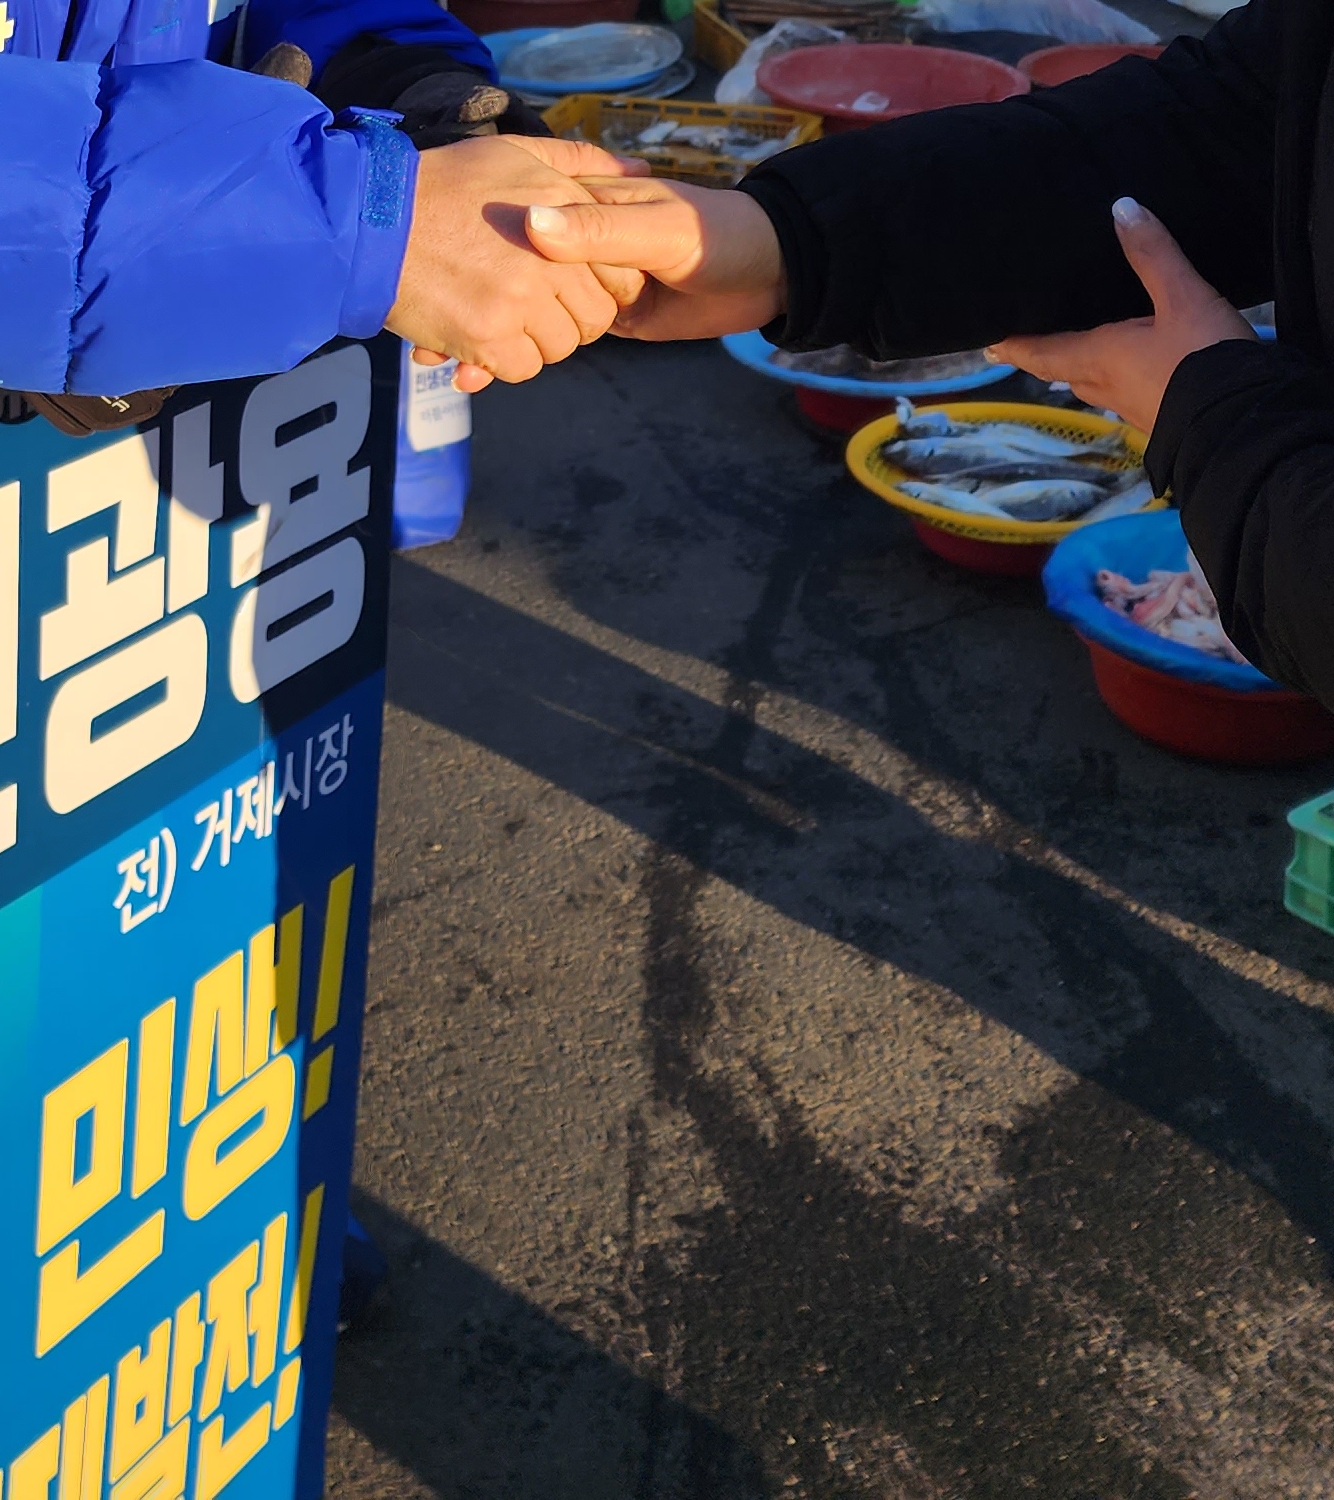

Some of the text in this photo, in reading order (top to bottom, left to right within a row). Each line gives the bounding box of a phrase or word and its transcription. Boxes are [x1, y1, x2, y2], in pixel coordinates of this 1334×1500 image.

[113, 713, 354, 934] 전) 거제시장
[35, 865, 355, 1359] 민생!
